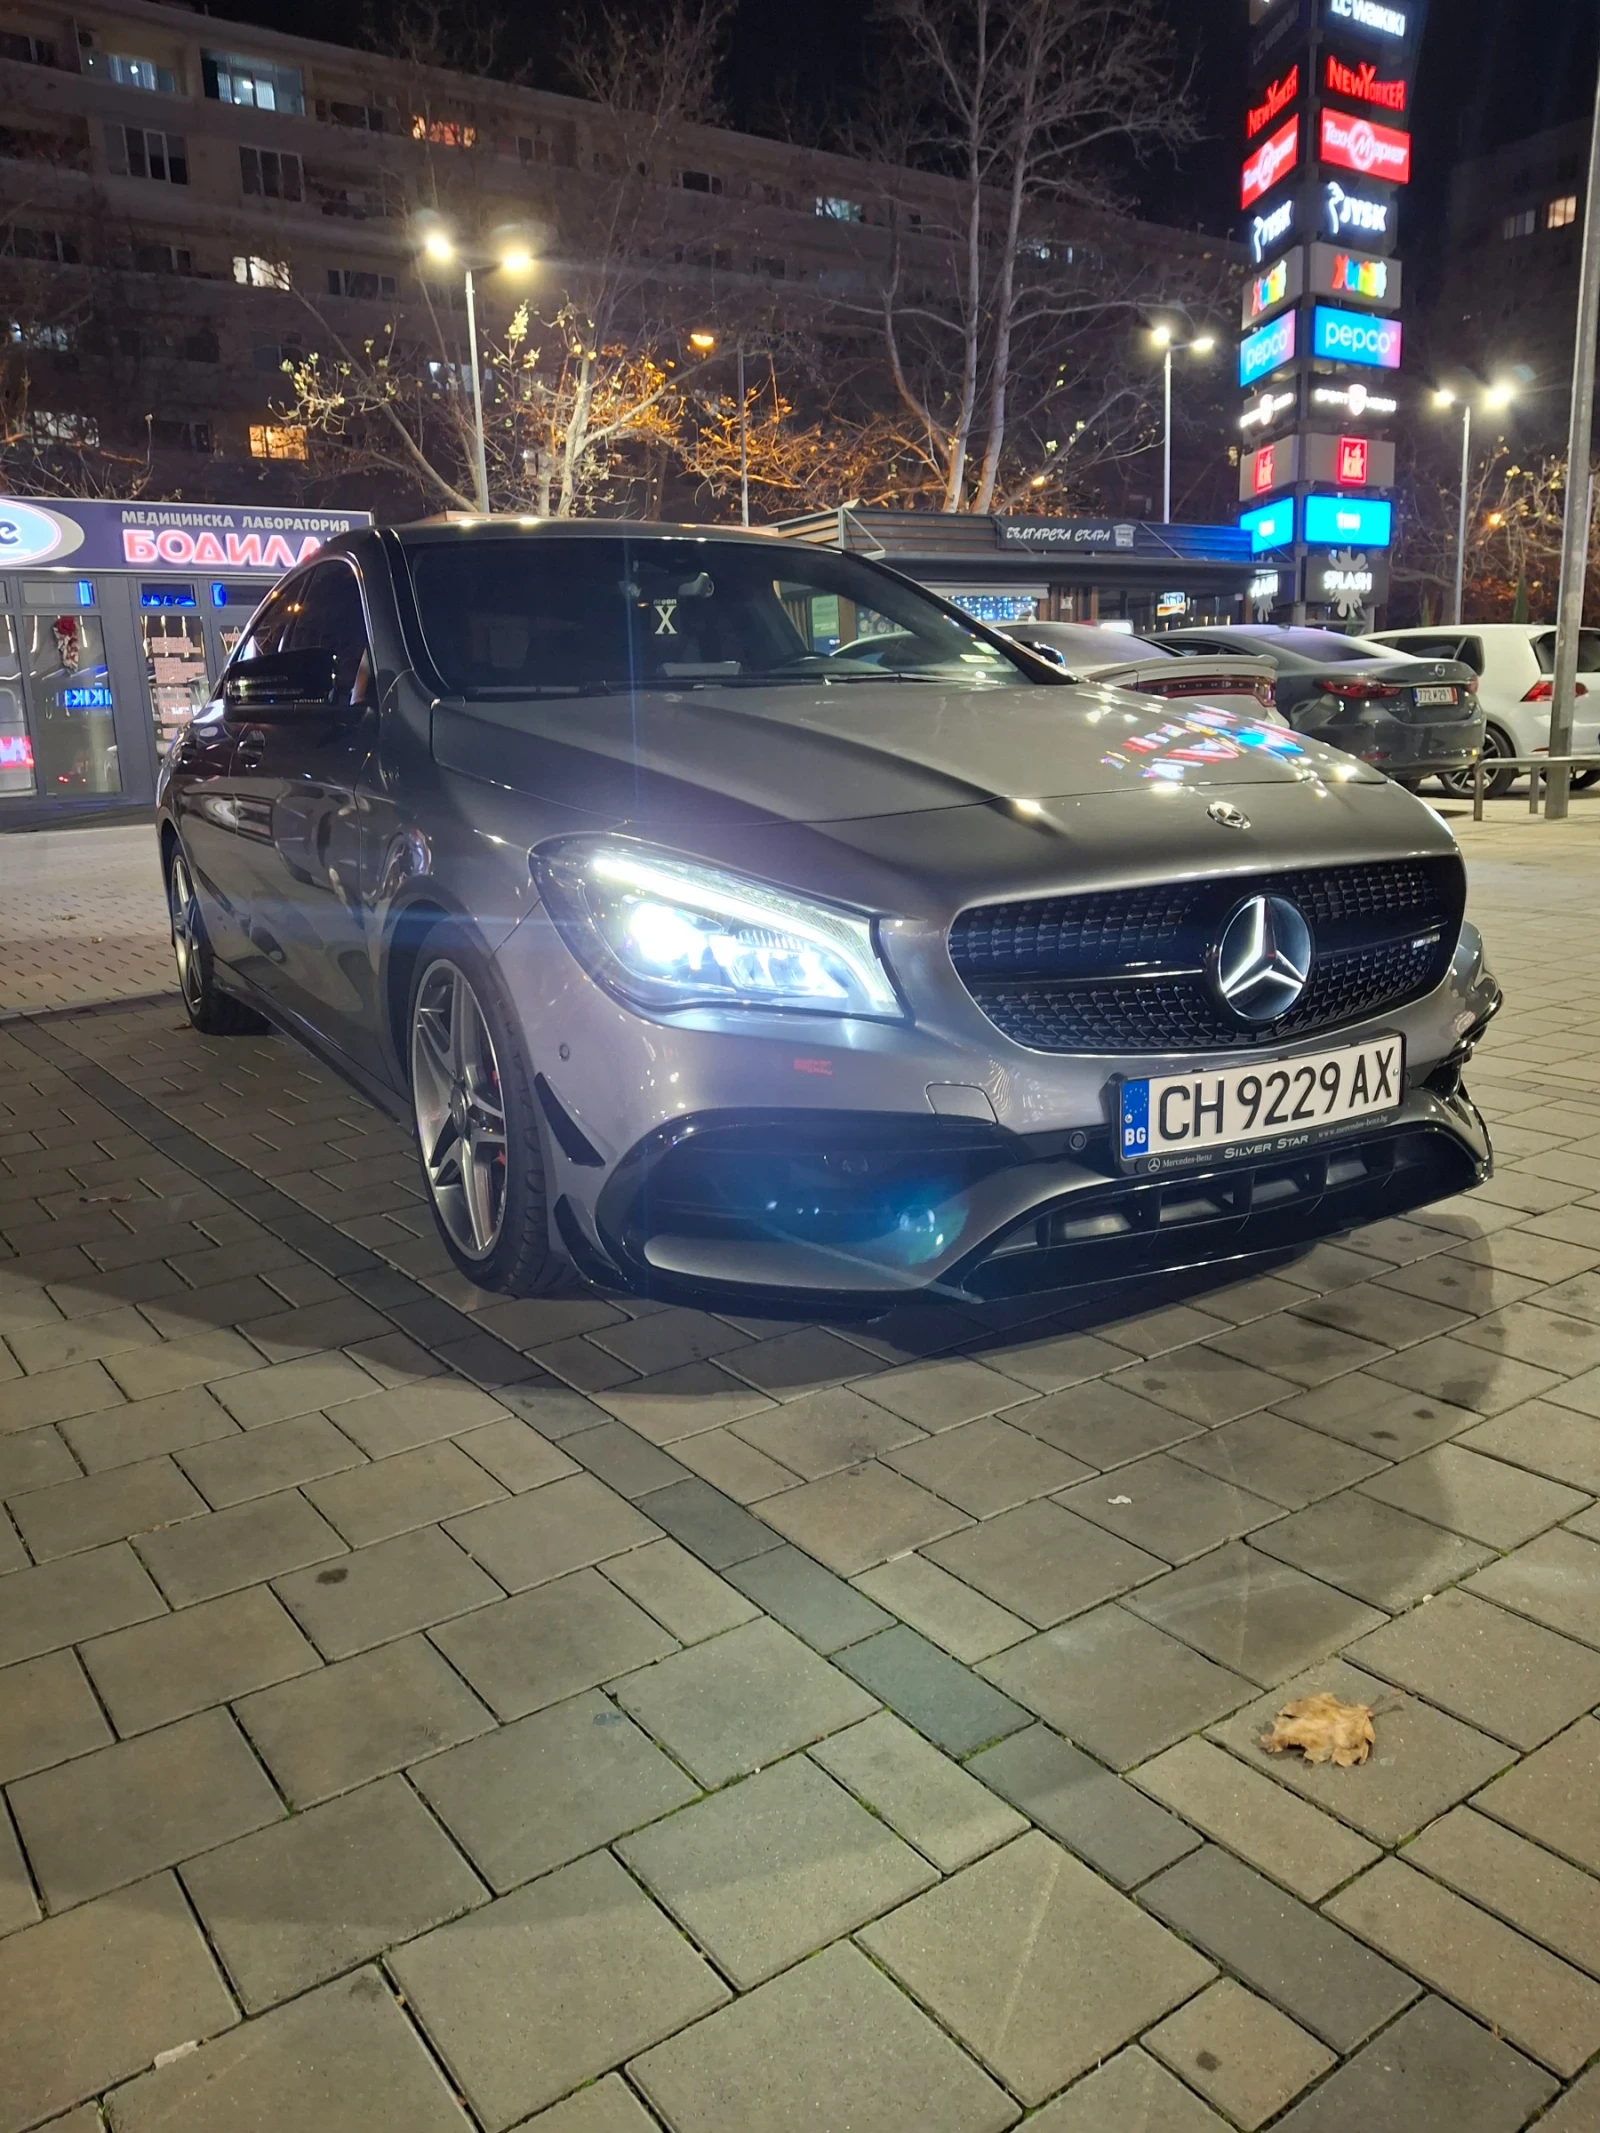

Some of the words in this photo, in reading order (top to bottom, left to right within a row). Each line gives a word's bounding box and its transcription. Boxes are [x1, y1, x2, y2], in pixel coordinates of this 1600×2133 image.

[1325, 321, 1391, 354] pepco
[1245, 328, 1288, 375] pepco
[121, 510, 235, 529] МЕДИЦИНСКА
[242, 515, 350, 533] ЛАБОРАТОРИЯ
[1074, 528, 1111, 542] СКАРА
[1323, 570, 1373, 591] SPLASH
[654, 605, 678, 634] X
[1159, 1077, 1225, 1141] CH
[1237, 1061, 1341, 1130] 9229
[1349, 1047, 1395, 1108] AX
[1125, 1128, 1147, 1146] BG
[1162, 1154, 1213, 1168] Mercedes-Benz
